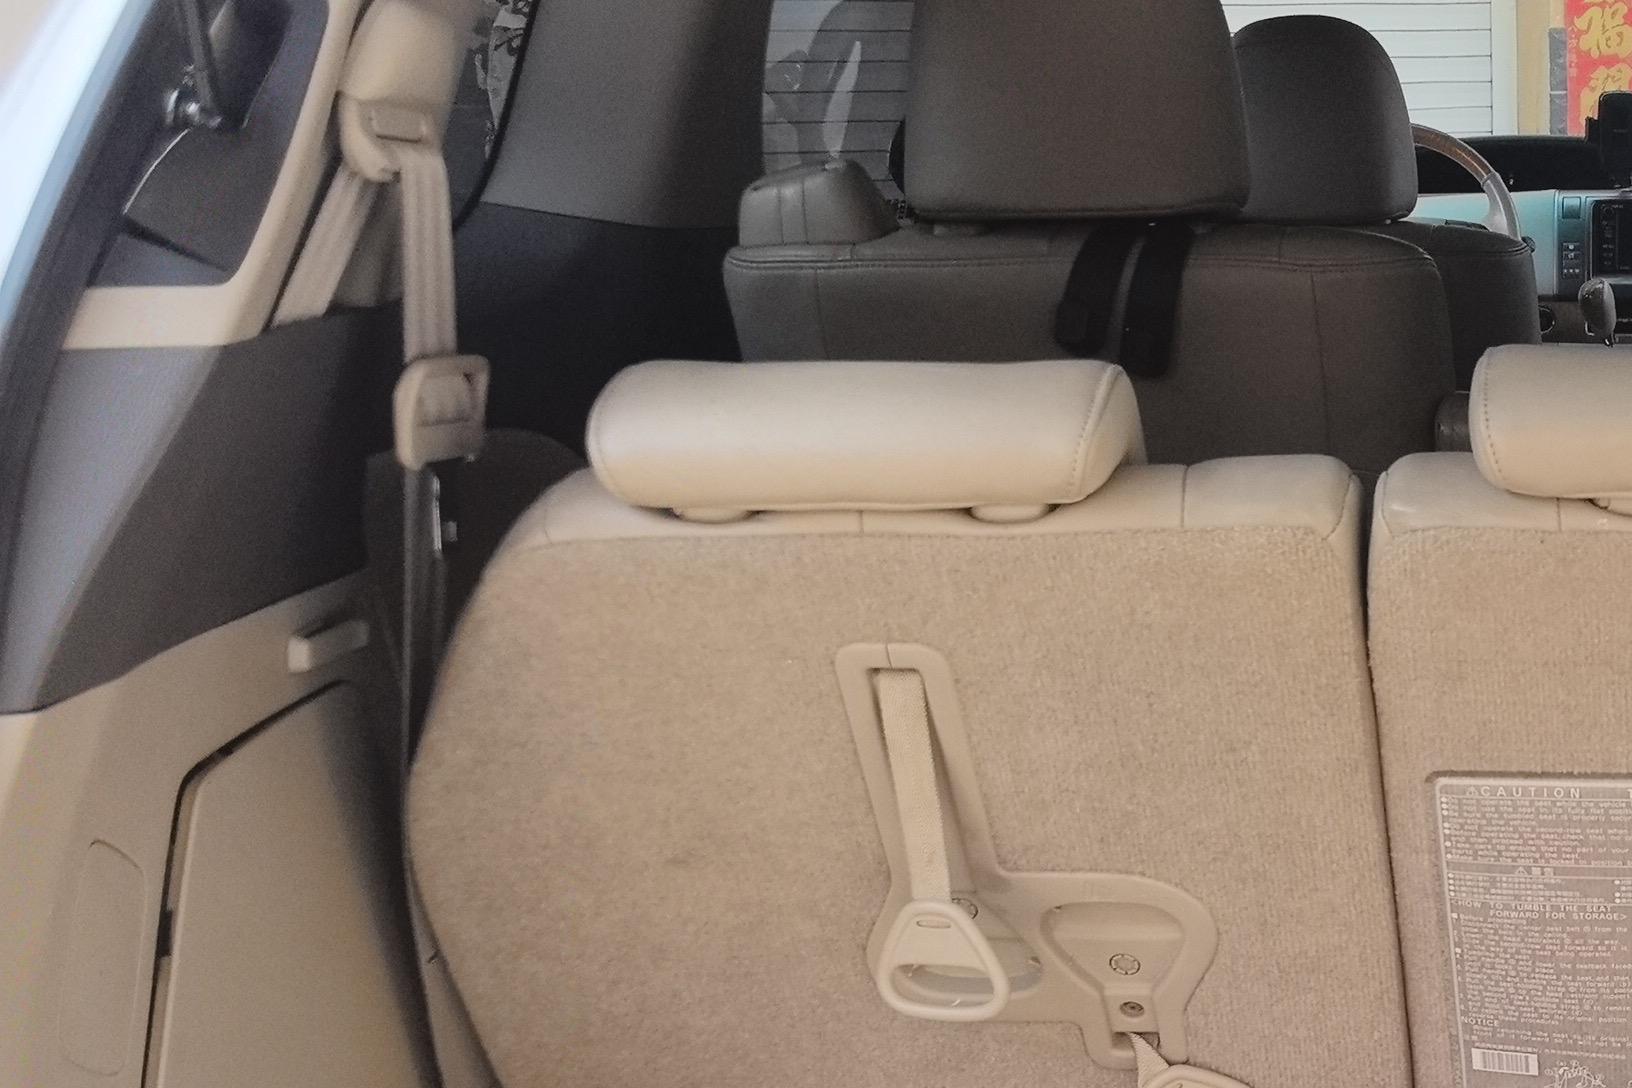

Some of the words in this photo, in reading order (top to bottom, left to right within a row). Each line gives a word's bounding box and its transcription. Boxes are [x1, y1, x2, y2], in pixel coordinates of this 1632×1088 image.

[1481, 786, 1581, 799] CAUTION
[1511, 902, 1552, 912] TUMBLE
[1559, 903, 1578, 912] THE
[1586, 904, 1613, 914] SEAT
[1489, 909, 1540, 919] FORWARD
[1545, 911, 1567, 921] FOR
[1463, 1015, 1500, 1027] NOTICE
